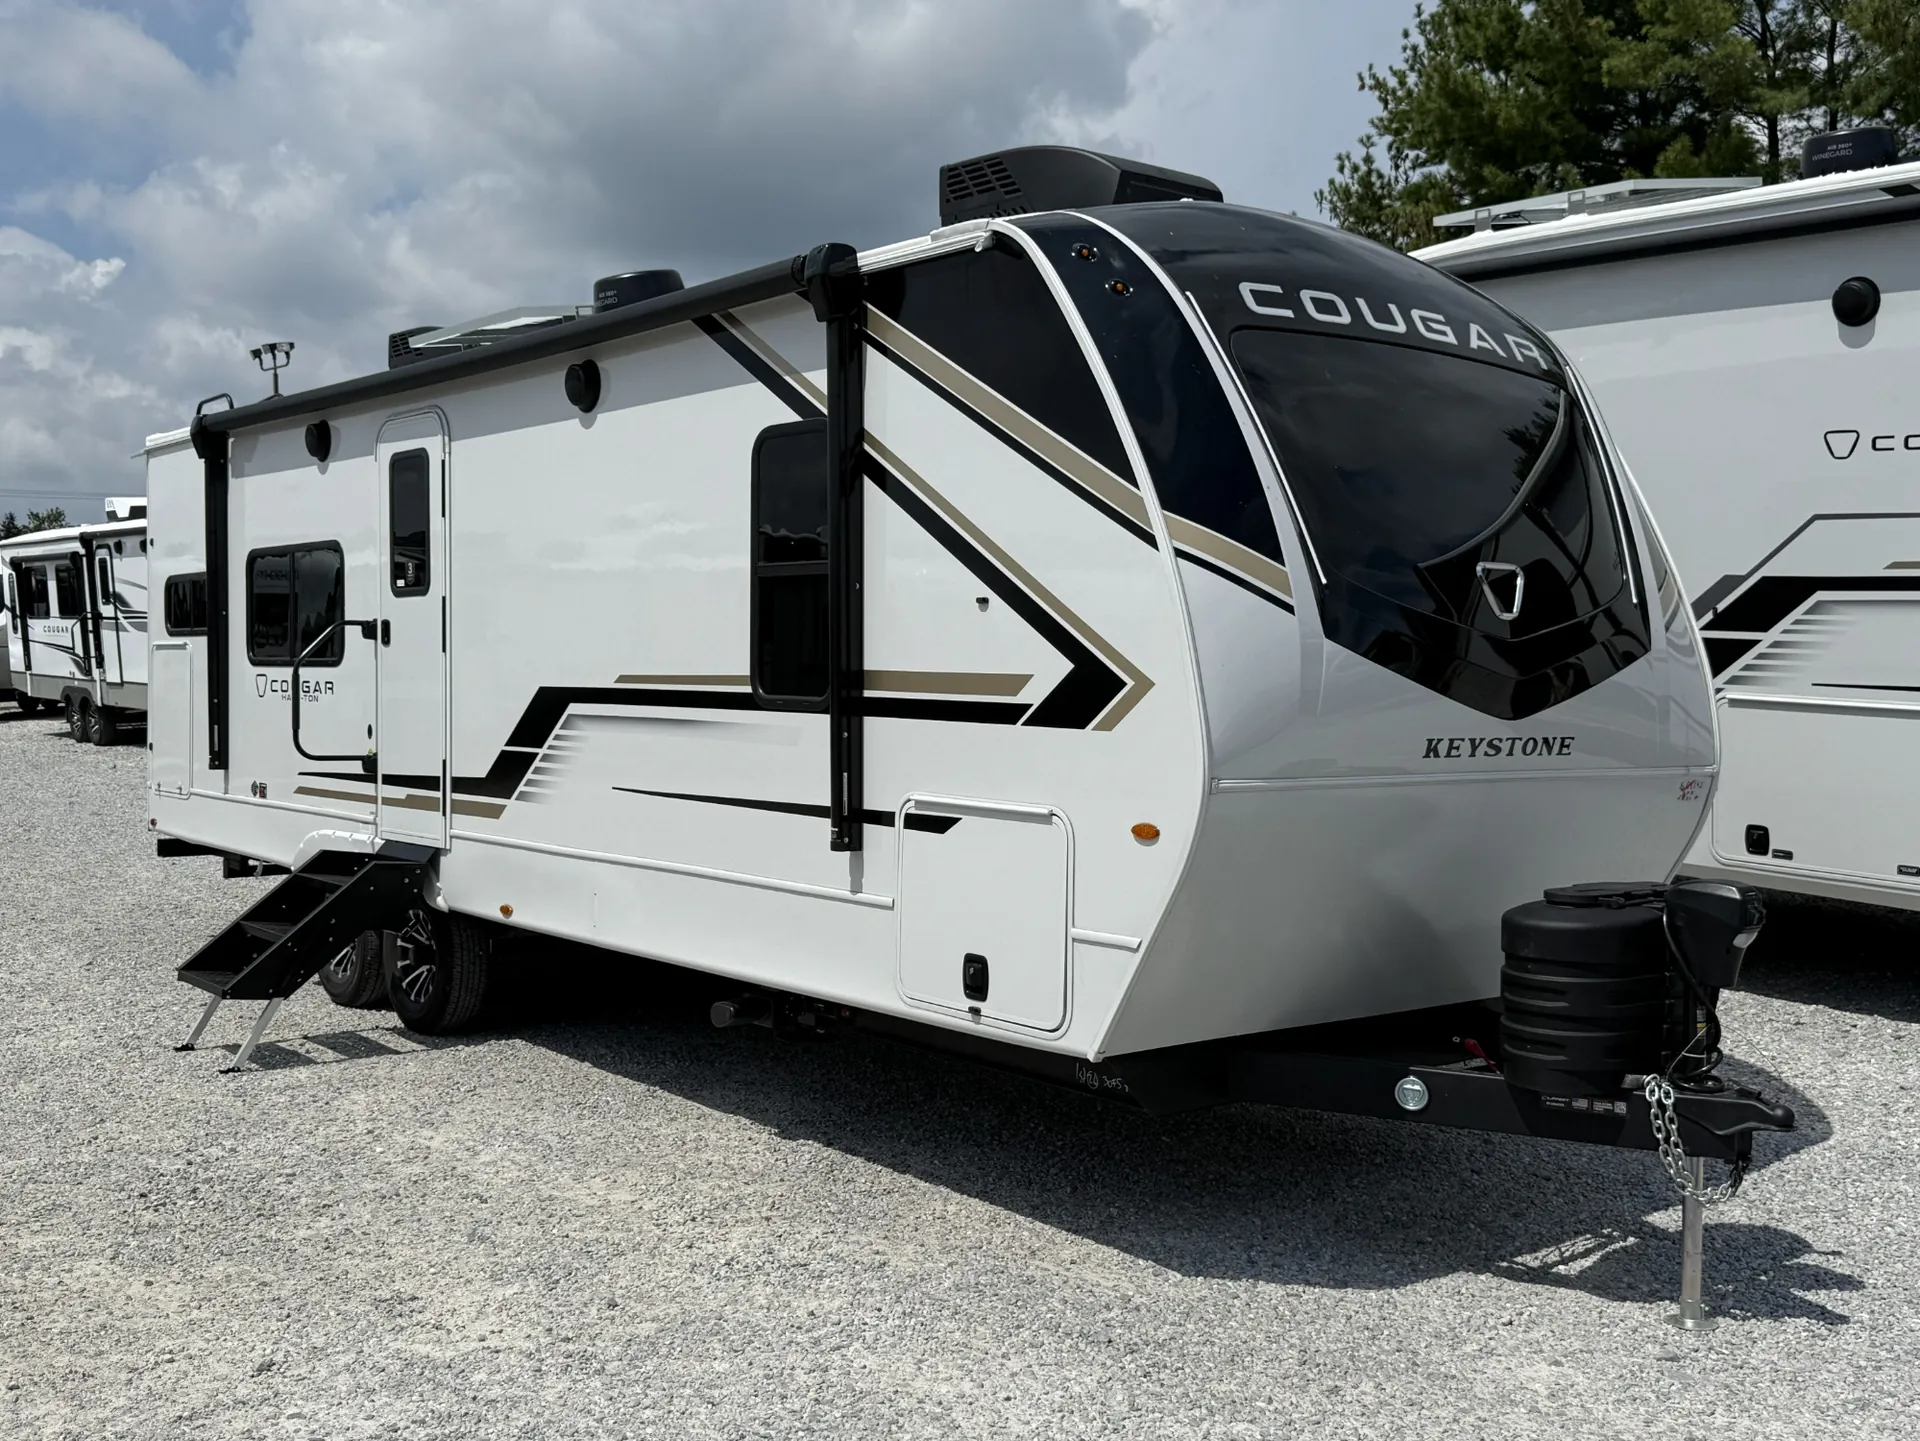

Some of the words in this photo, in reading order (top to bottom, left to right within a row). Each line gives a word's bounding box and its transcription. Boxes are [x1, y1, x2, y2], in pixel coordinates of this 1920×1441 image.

[1811, 148, 1853, 162] WINEGARD
[1238, 281, 1549, 370] COUGAR
[43, 625, 69, 634] COUGAR
[270, 679, 334, 695] COGAR
[281, 694, 319, 703] HA-TON
[1422, 736, 1575, 759] KEYSTONE
